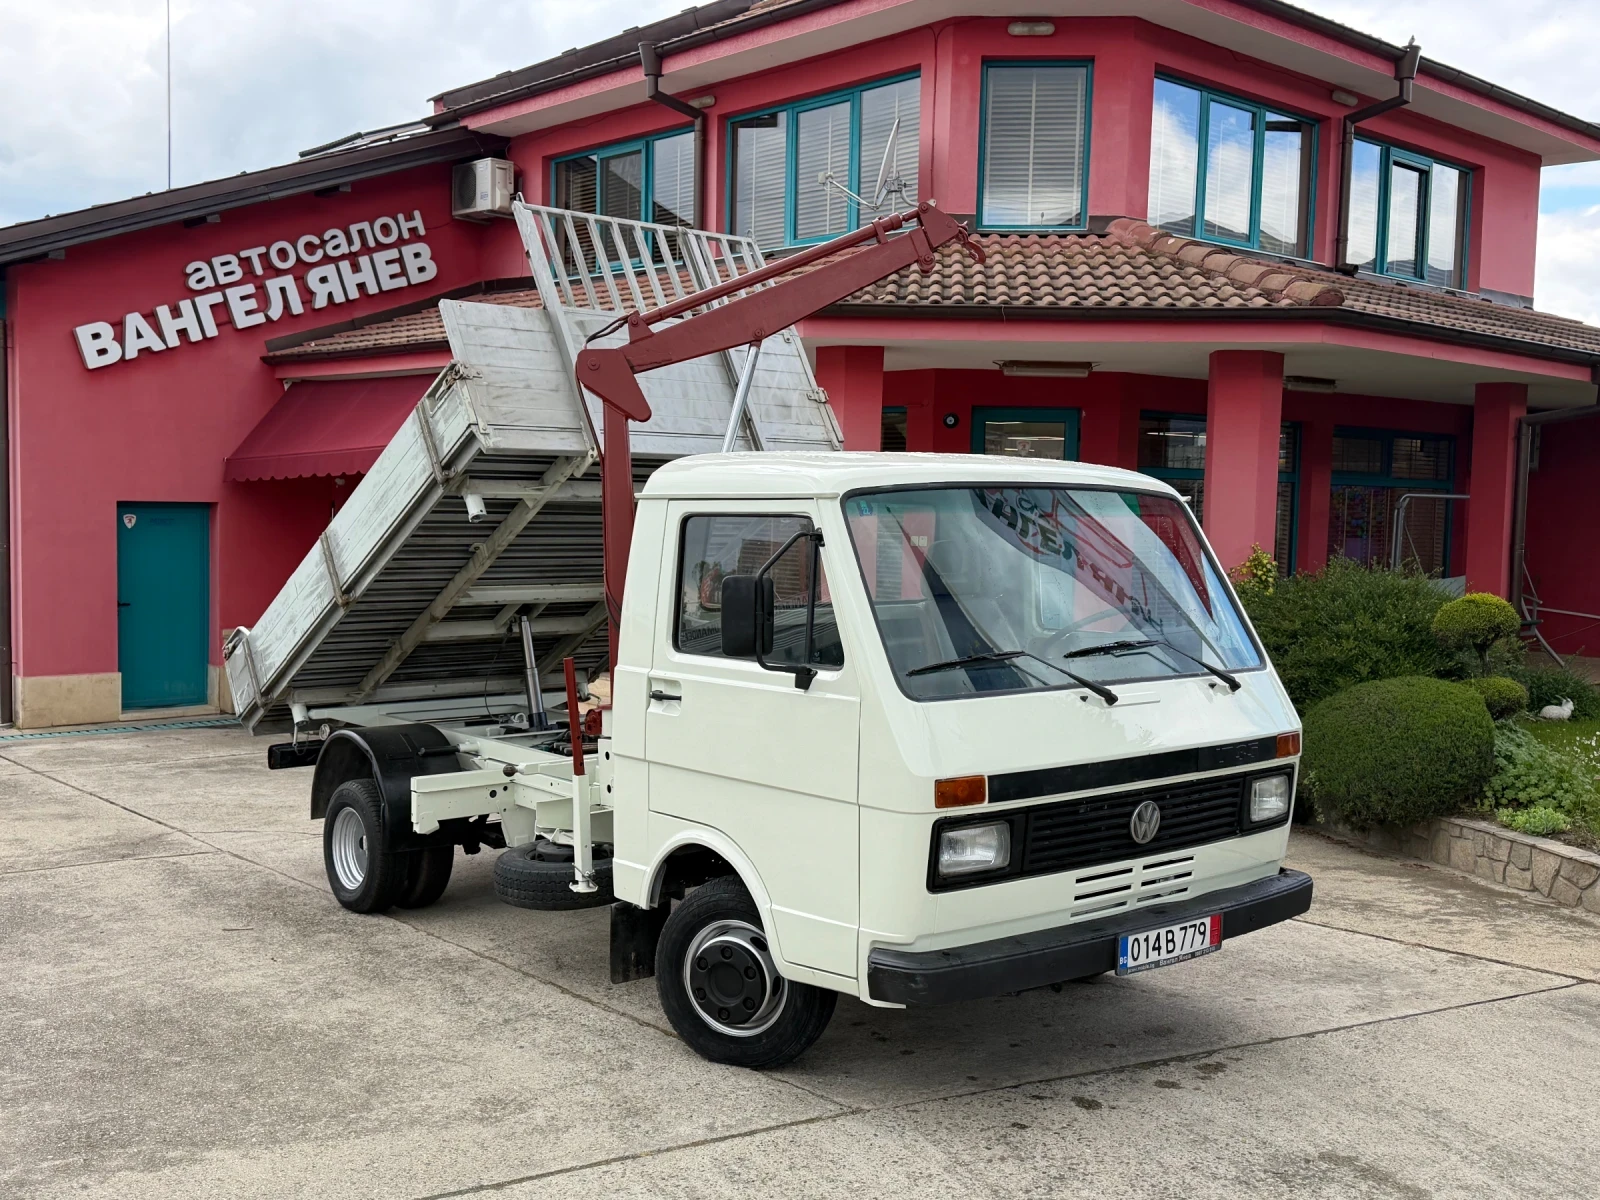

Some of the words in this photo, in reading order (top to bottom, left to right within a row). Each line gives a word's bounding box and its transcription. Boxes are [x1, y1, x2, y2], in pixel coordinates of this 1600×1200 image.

[185, 209, 425, 291] автосалон
[73, 274, 304, 370] ВАНГЕЛ
[304, 242, 438, 310] ЯНЕВ
